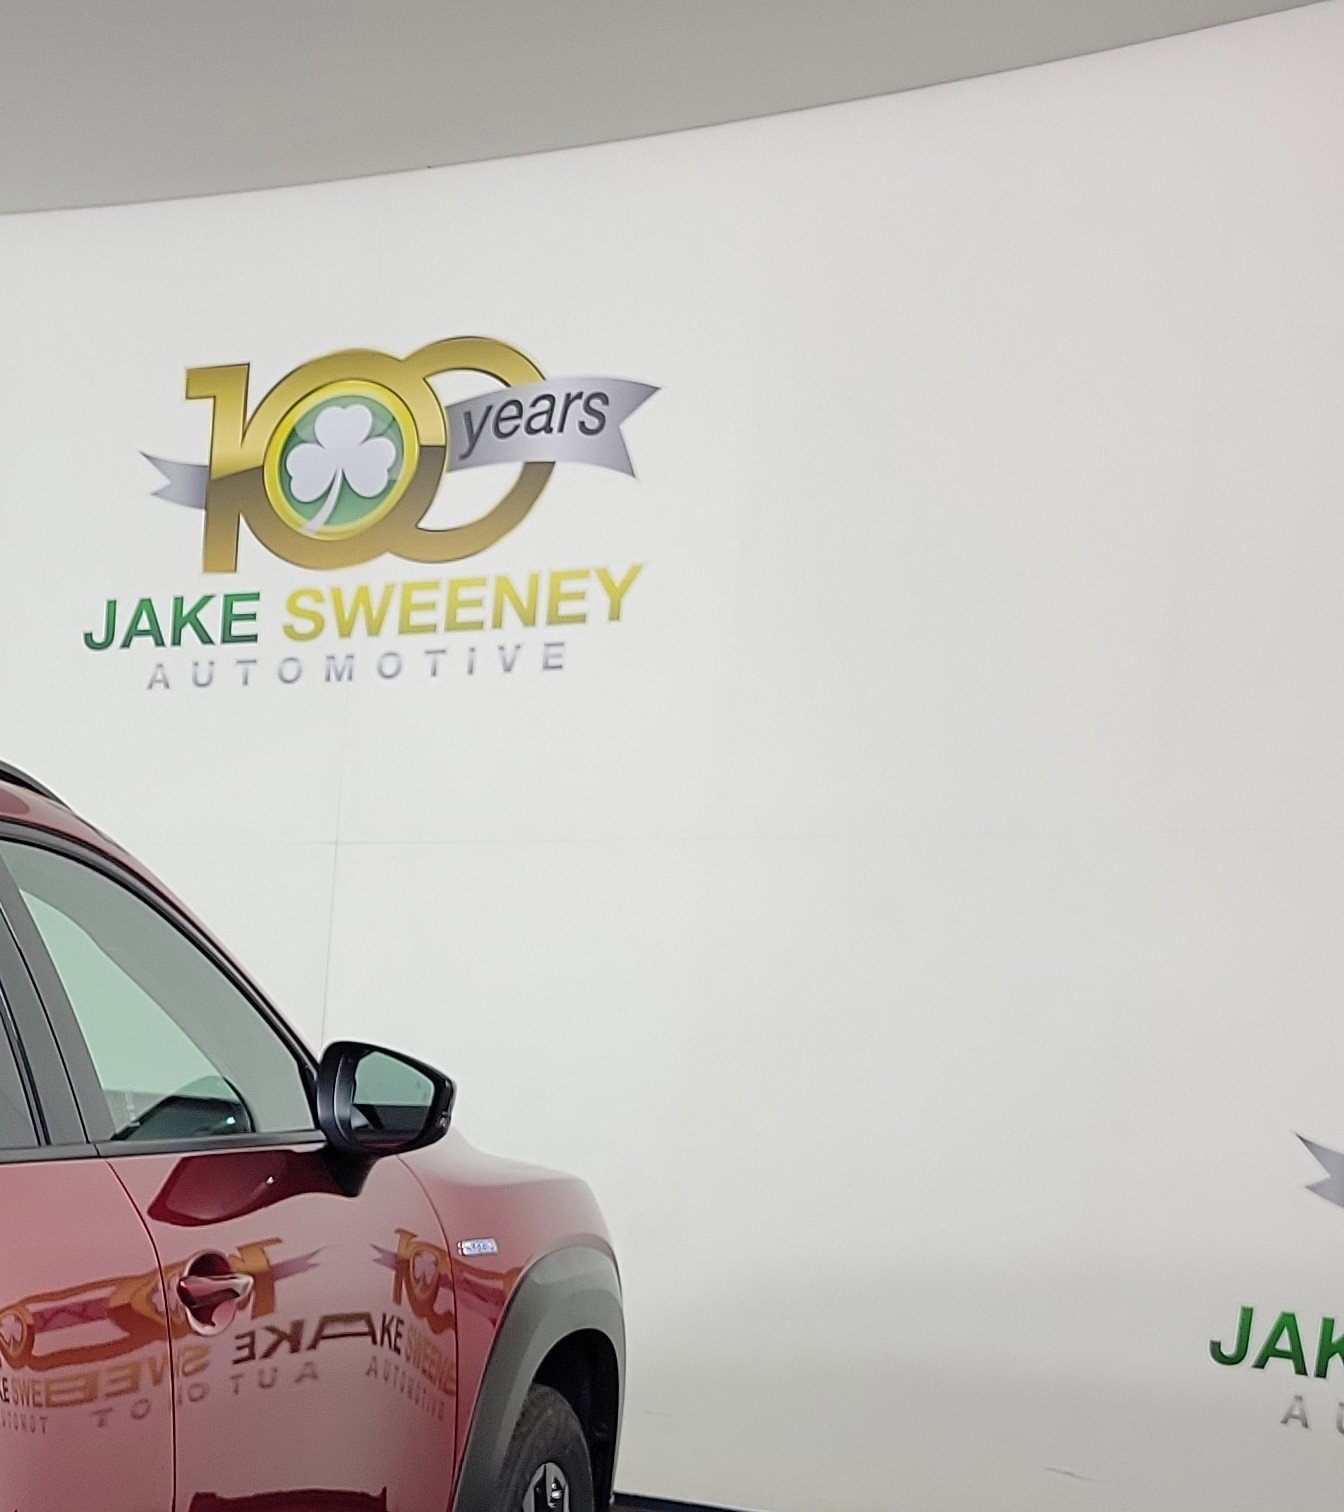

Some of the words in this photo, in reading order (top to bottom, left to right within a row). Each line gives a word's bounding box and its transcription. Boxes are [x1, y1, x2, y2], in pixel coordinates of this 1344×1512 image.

[458, 385, 610, 461] years
[83, 591, 261, 652] JAKE
[282, 564, 645, 644] SWEENEY
[146, 641, 567, 691] AUTOMOTIVE
